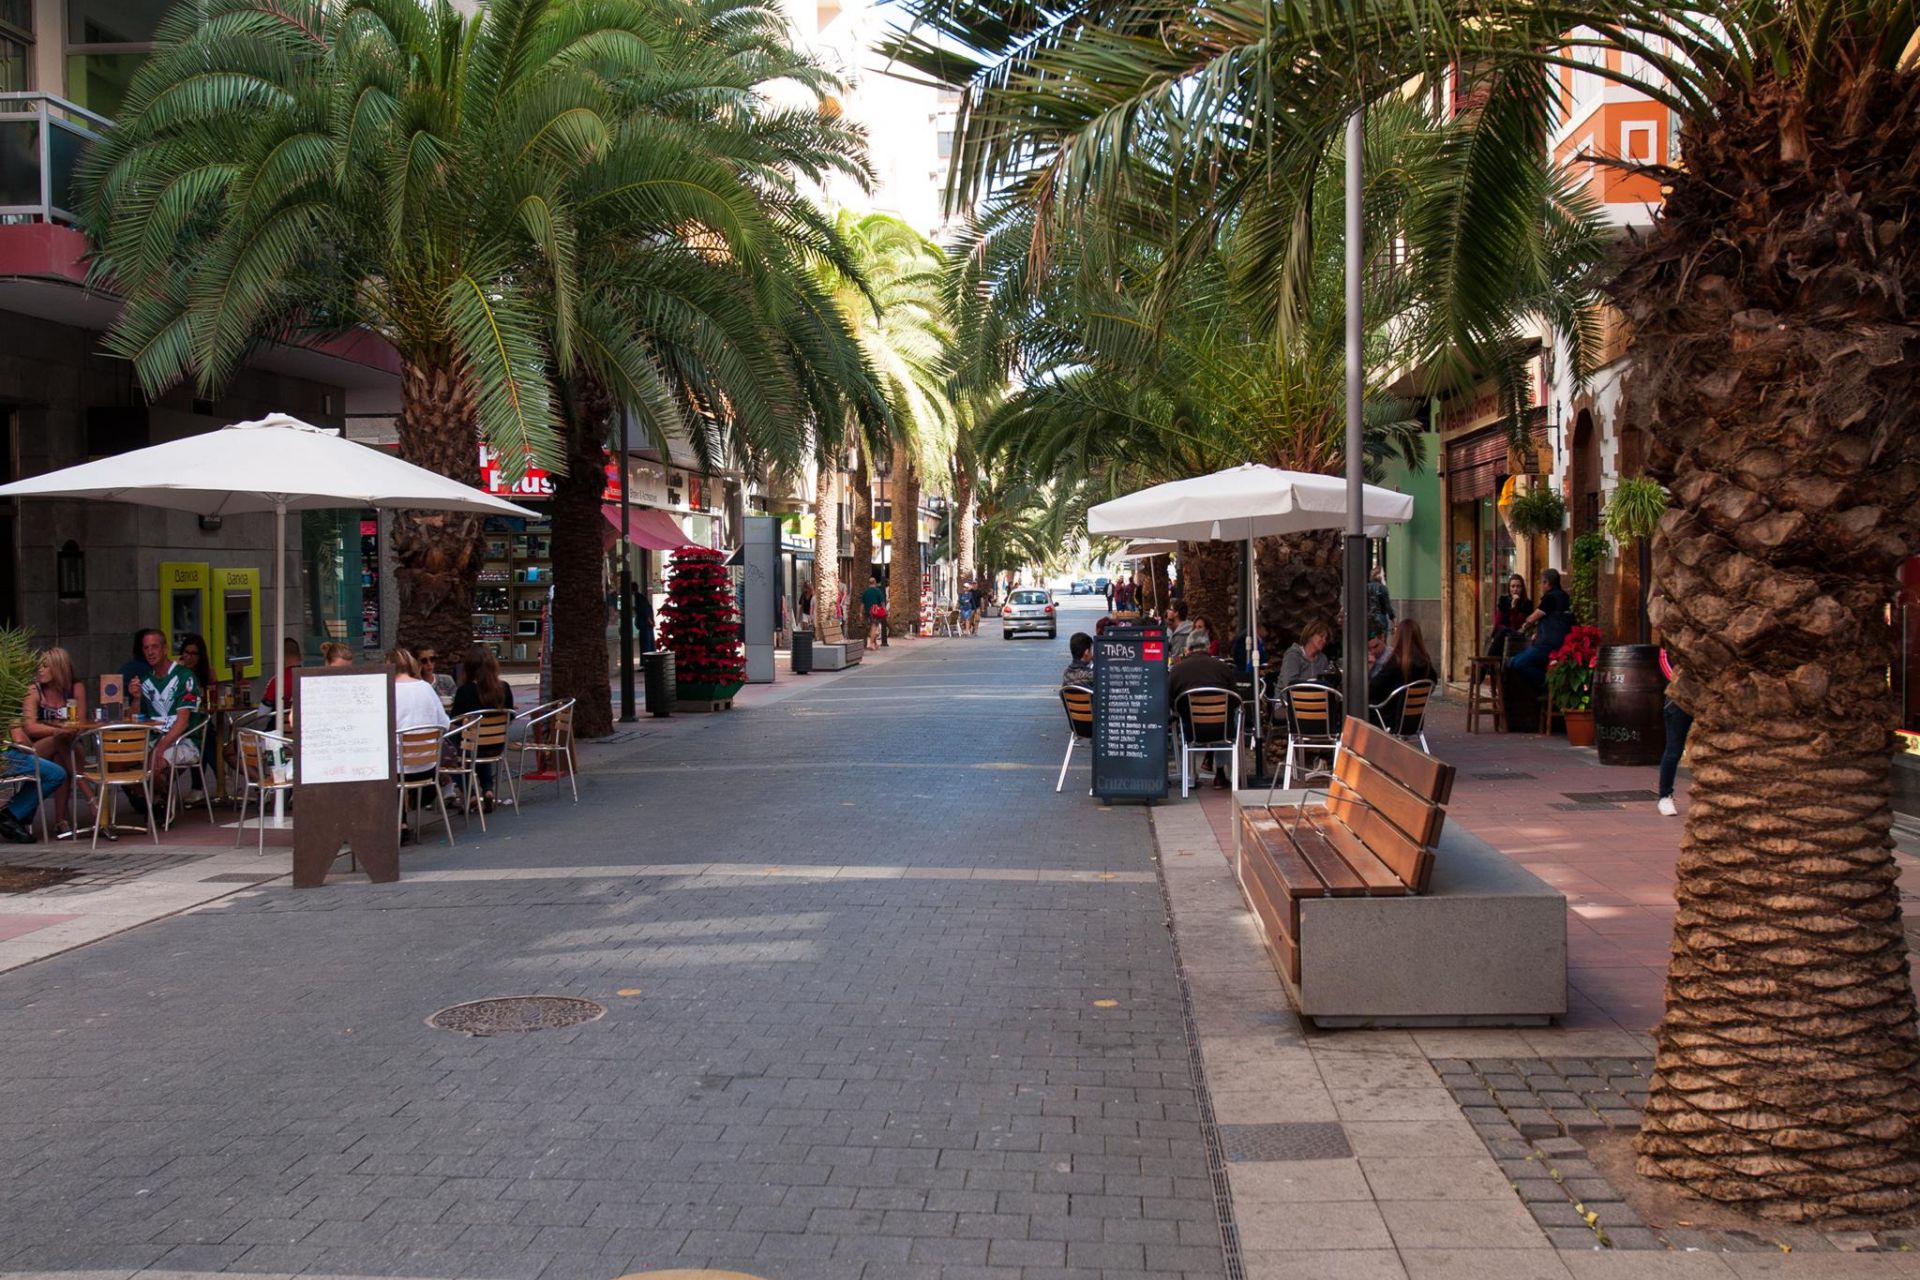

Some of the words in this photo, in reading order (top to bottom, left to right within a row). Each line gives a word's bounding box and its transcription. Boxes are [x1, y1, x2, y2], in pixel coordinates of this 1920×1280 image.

[175, 569, 199, 583] Bankia
[226, 572, 249, 585] Bankia
[1103, 643, 1136, 659] TAPAS
